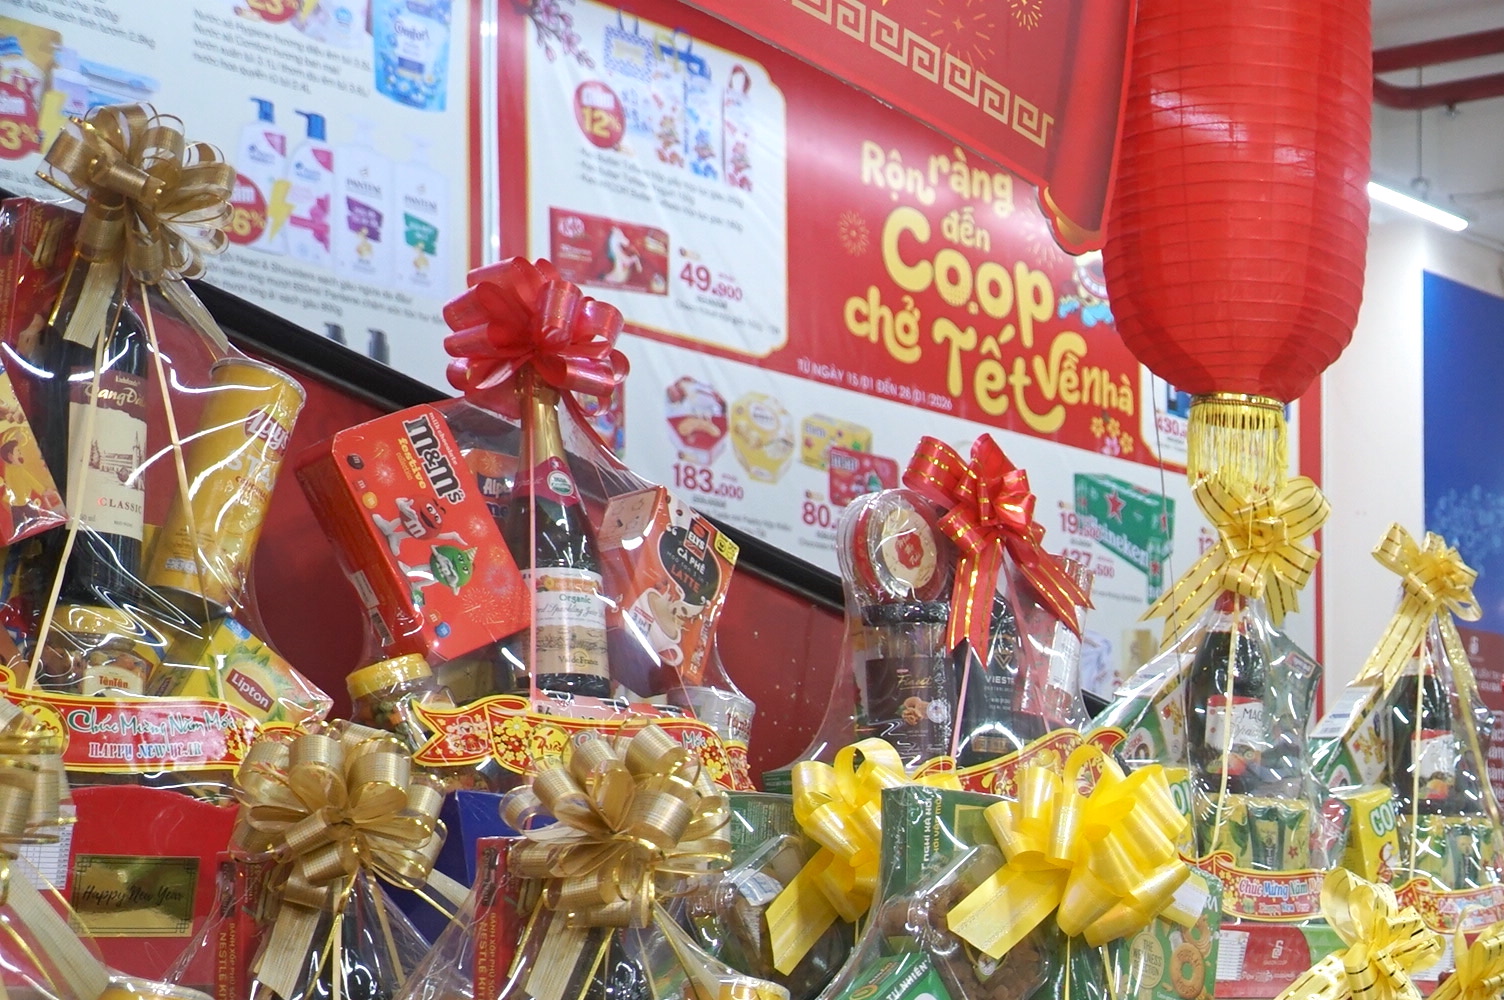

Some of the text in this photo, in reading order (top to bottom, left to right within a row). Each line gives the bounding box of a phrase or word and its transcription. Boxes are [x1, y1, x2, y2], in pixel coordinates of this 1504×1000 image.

[861, 140, 1015, 218] Rộn ràng
[941, 206, 991, 253] đến
[932, 318, 1066, 433] Tết
[1081, 367, 1135, 417] nhà
[398, 437, 426, 489] festive
[688, 531, 706, 551] ELYS
[671, 563, 700, 594] LATTE
[559, 594, 591, 605] Organic
[231, 672, 269, 708] Lipton
[67, 705, 119, 734] Chúc
[89, 742, 133, 760] HAPPY
[82, 884, 125, 907] Happy
[156, 885, 182, 907] Year
